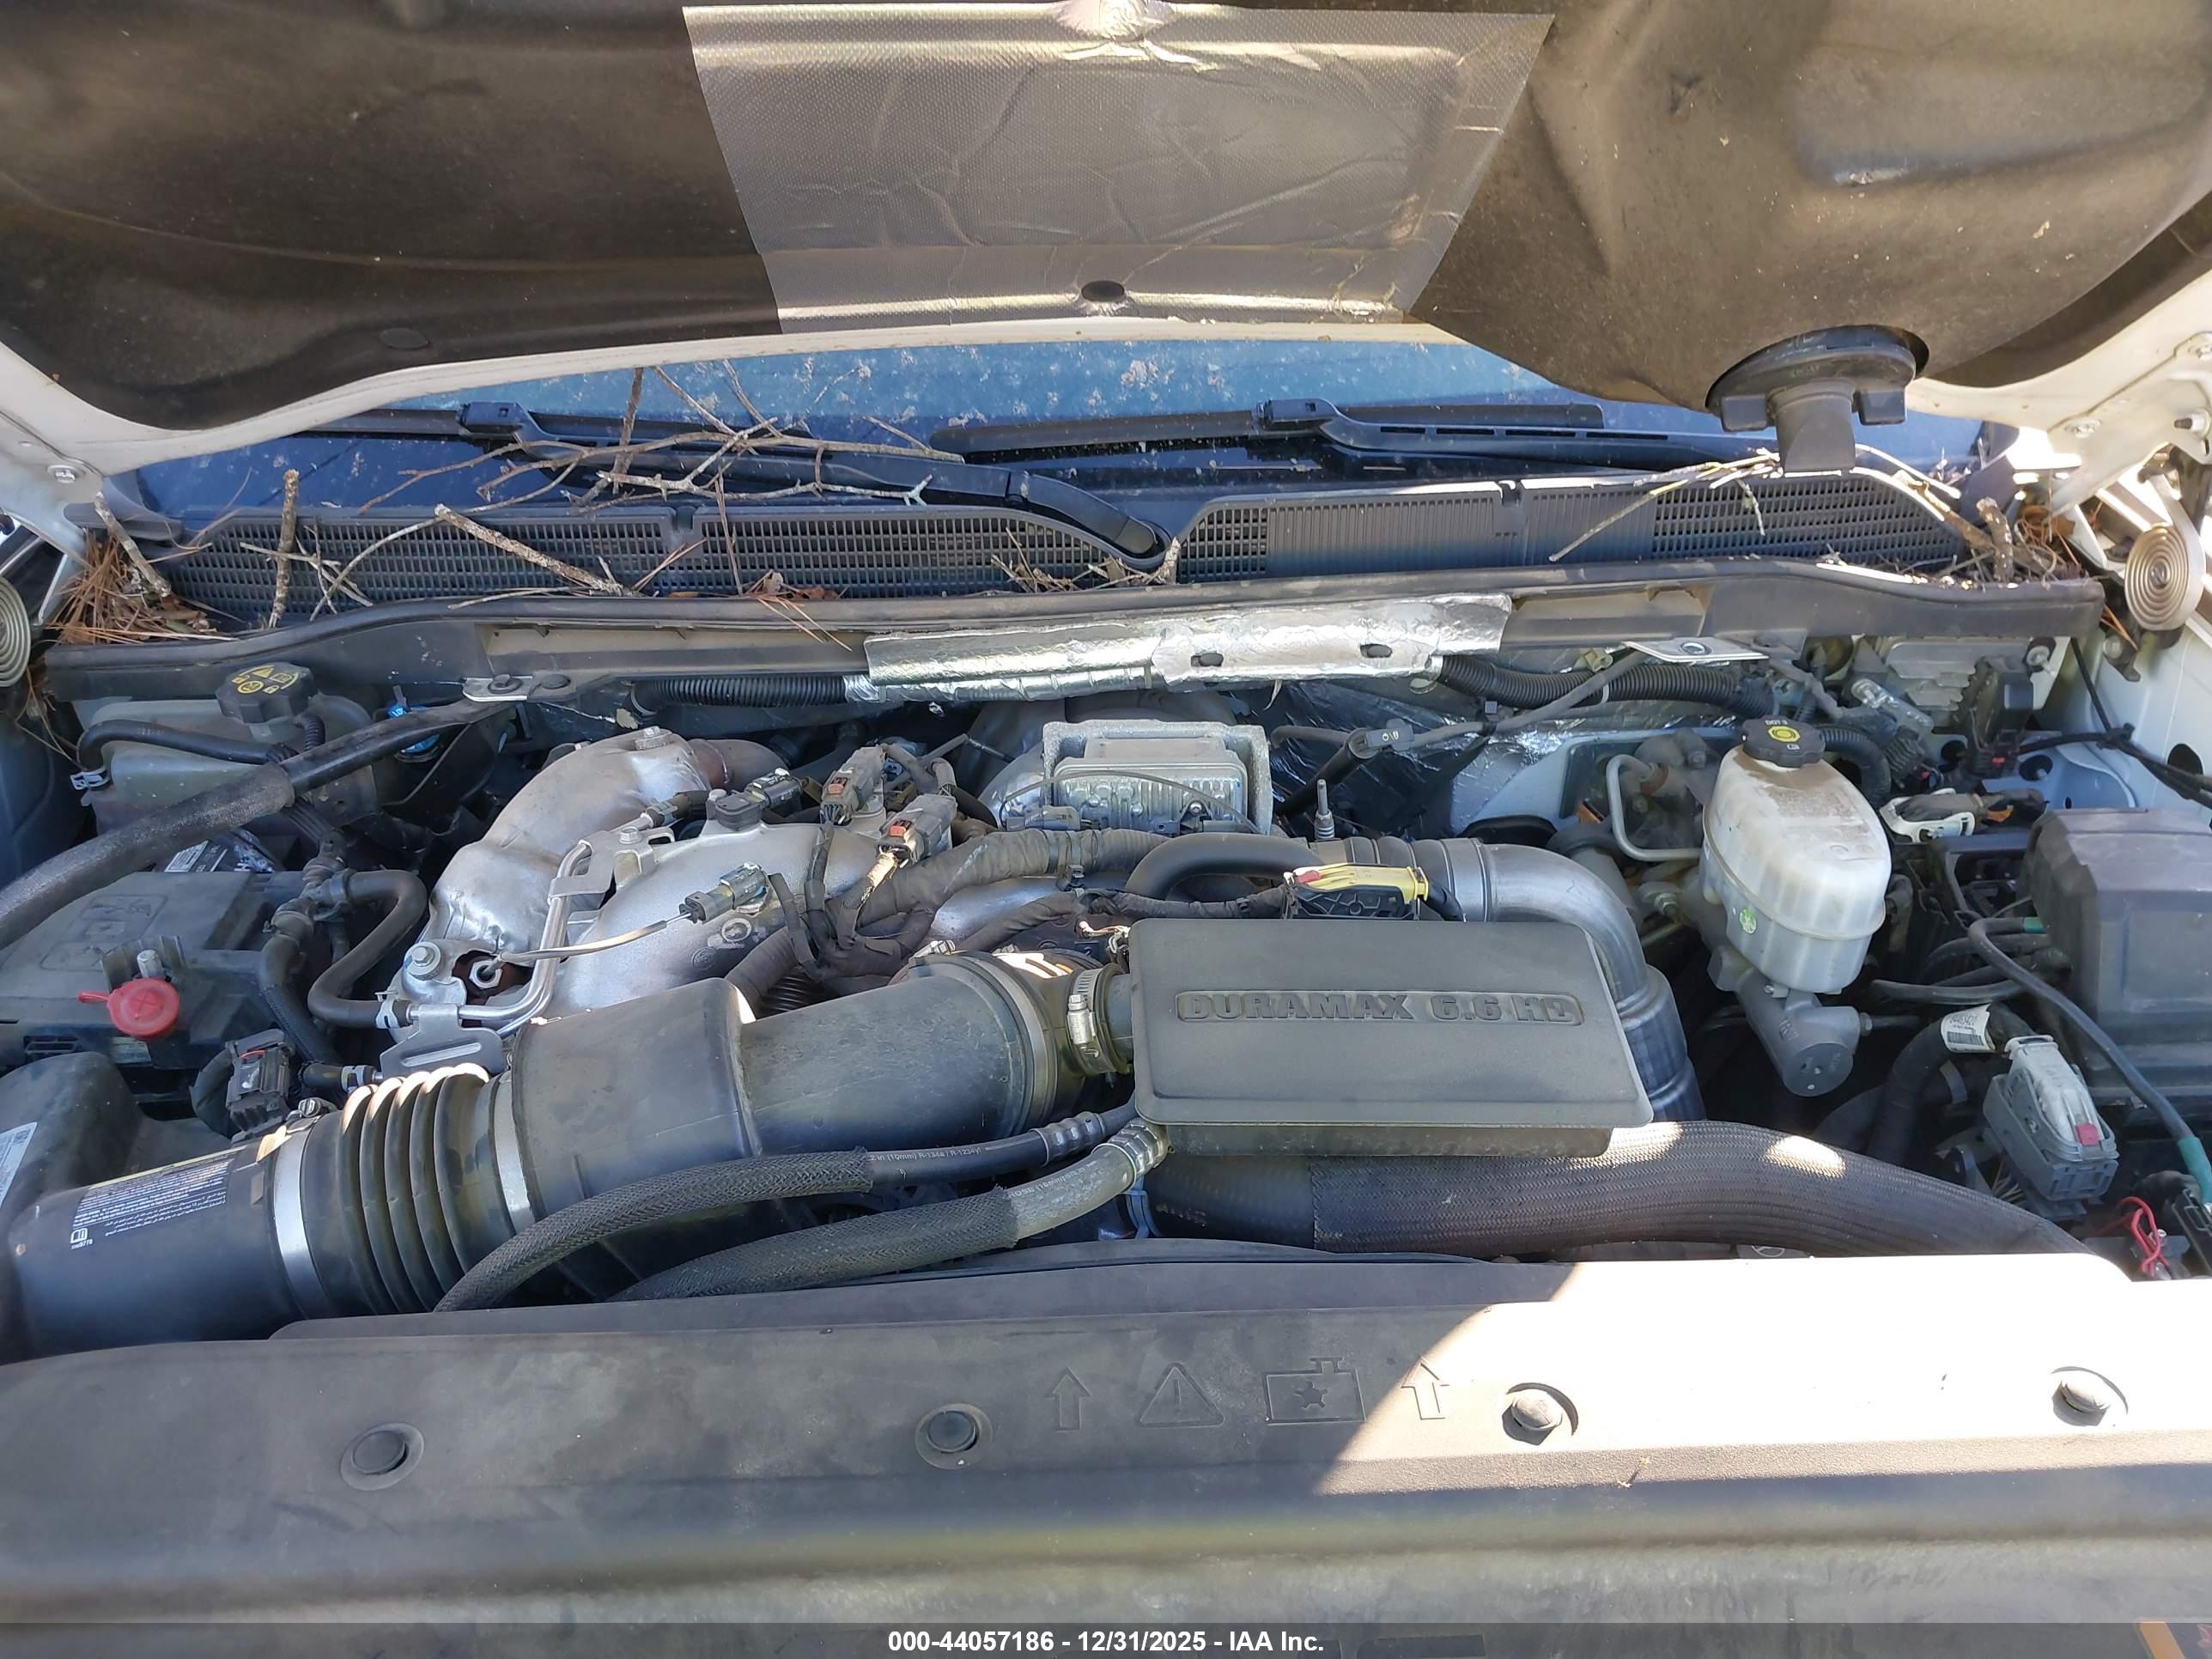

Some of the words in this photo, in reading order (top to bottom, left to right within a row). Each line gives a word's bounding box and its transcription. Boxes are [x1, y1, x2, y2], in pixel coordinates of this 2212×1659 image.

[1182, 993, 1415, 1022] DURAMAX
[1431, 994, 1504, 1023] 6.6
[1510, 995, 1578, 1024] HD
